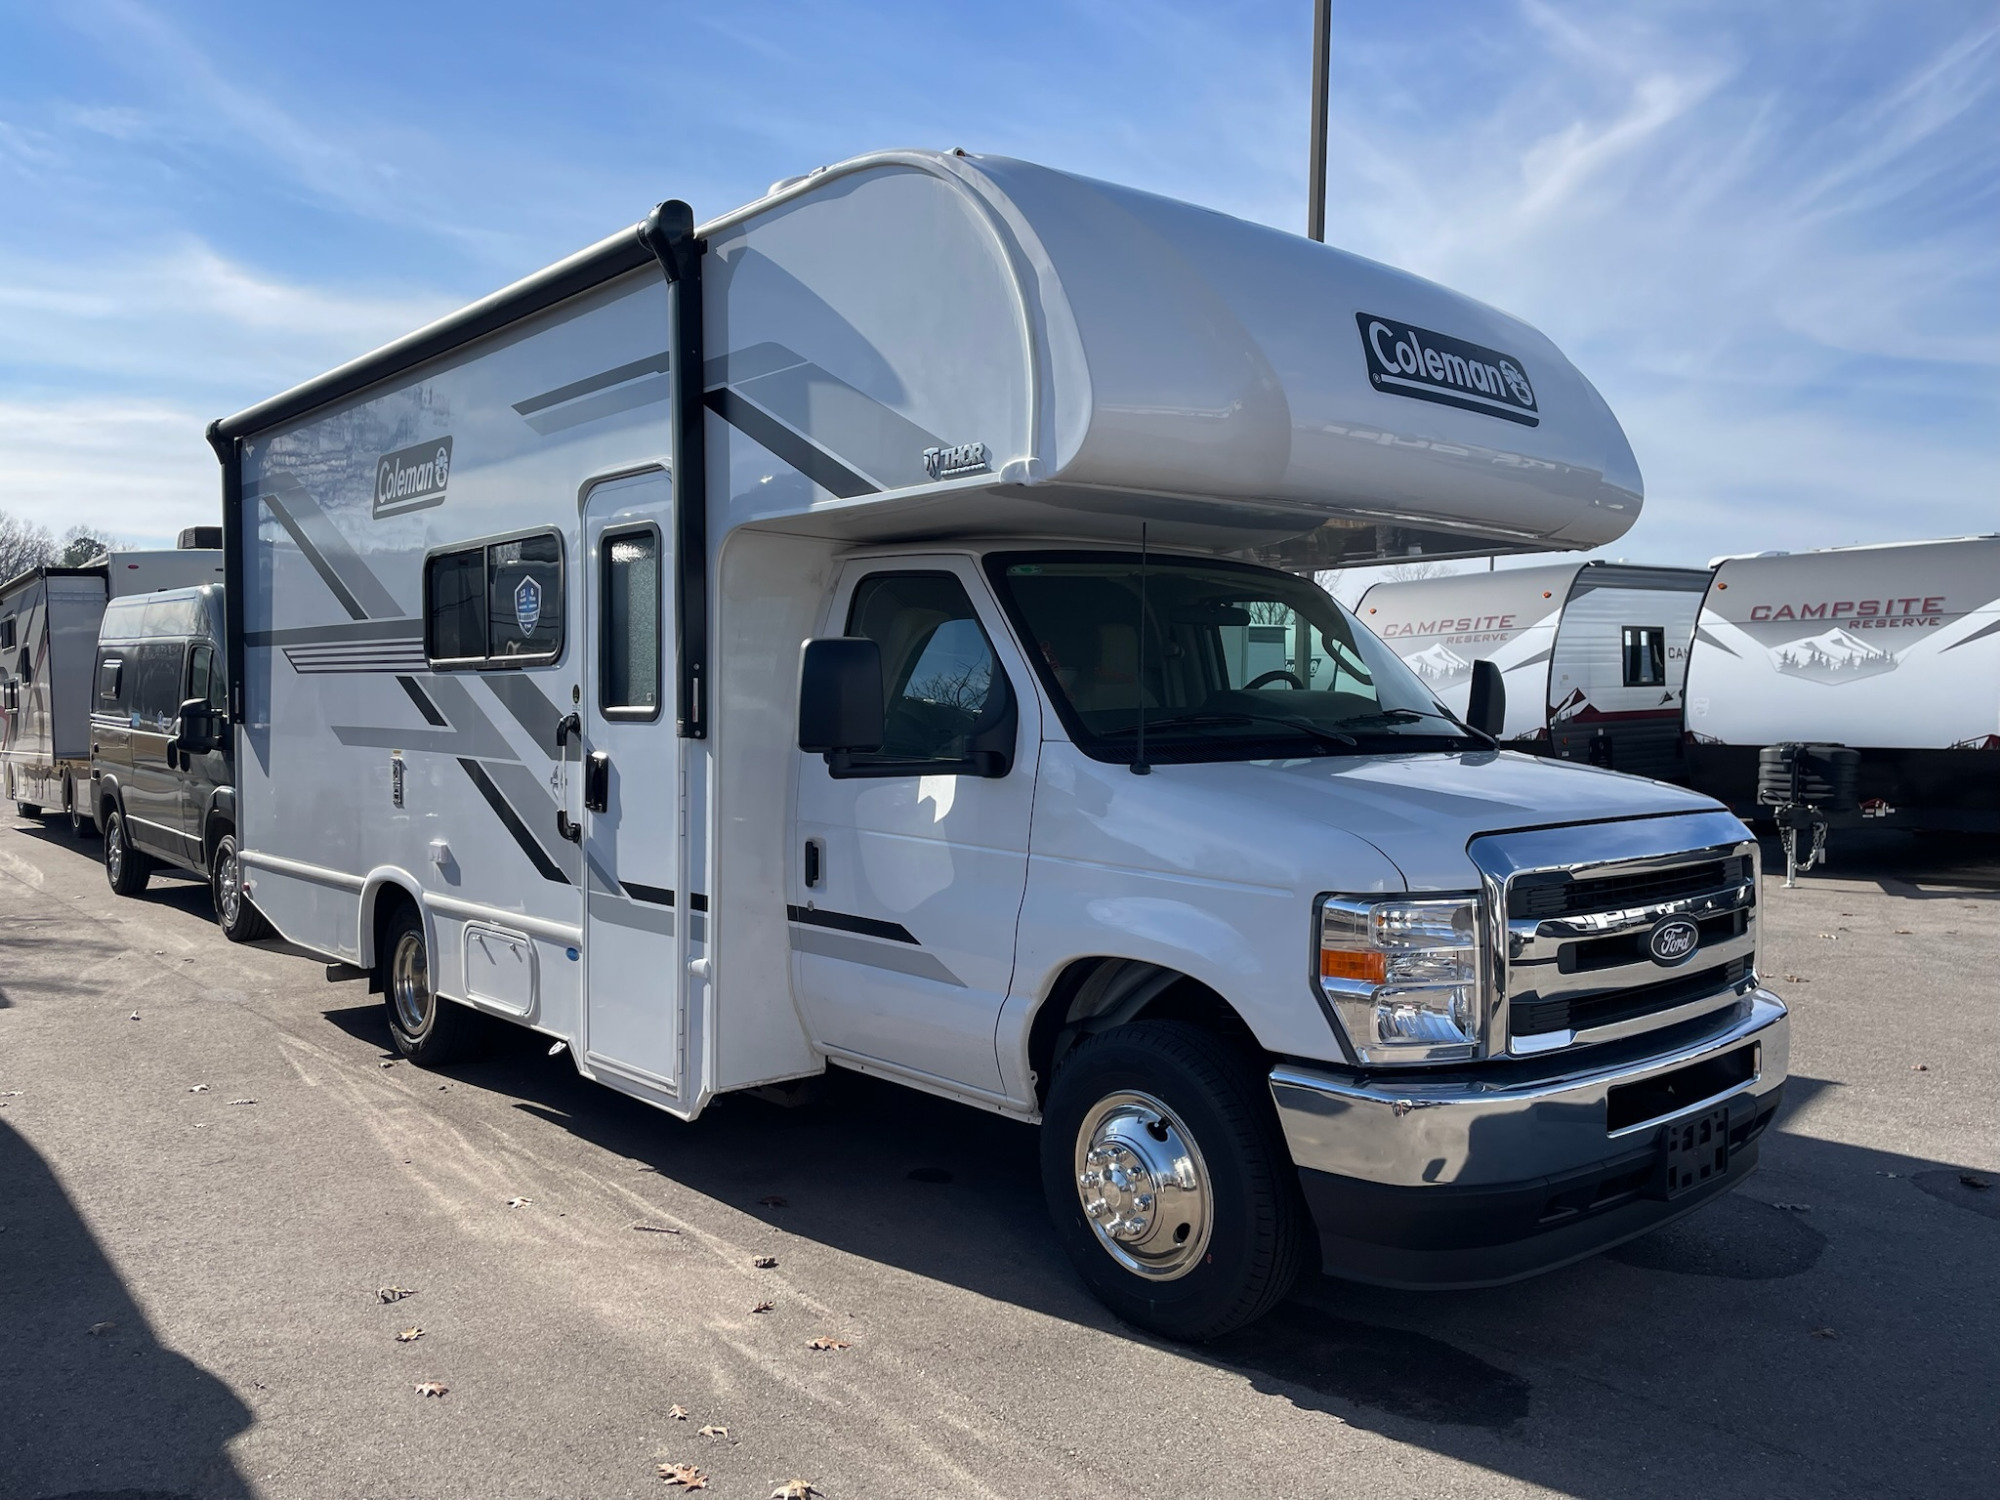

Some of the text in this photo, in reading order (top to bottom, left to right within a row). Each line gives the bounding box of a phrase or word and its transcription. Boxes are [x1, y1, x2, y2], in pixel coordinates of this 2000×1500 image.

[1368, 320, 1507, 398] Coleman
[940, 442, 985, 470] THOR
[378, 457, 434, 504] Coleman
[1750, 597, 1945, 621] CAMPSITE
[1383, 615, 1516, 637] CAMPSITE
[1849, 617, 1941, 629] RESERVE
[1446, 633, 1509, 645] RESERVE
[1661, 928, 1690, 954] Ford
